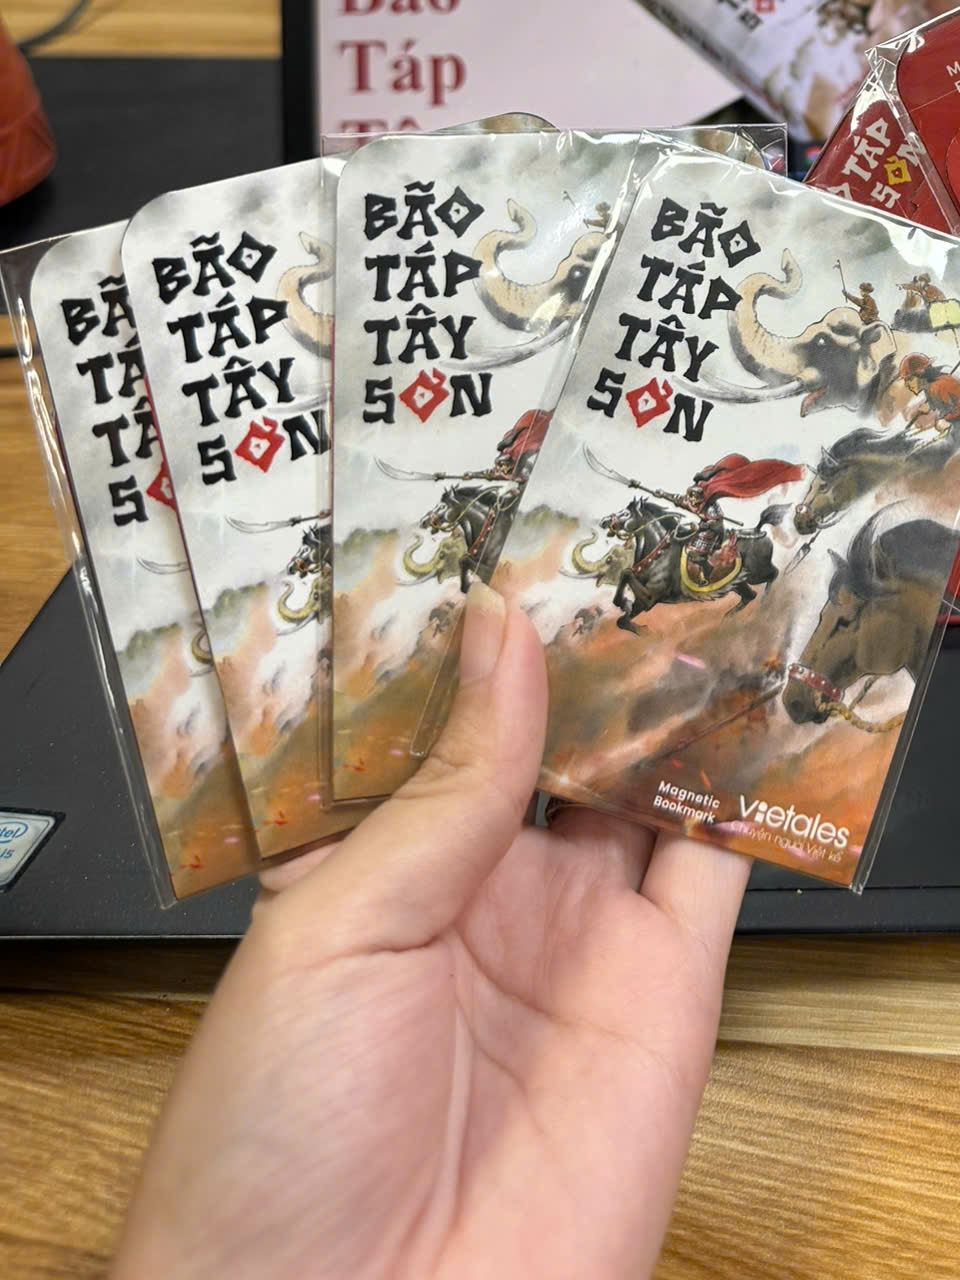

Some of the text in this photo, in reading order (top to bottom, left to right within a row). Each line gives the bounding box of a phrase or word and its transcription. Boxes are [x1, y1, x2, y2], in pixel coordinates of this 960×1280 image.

[337, 38, 468, 108] Táp
[842, 117, 892, 182] TÁP
[870, 131, 928, 209] SƠN
[364, 181, 485, 241] BÃO
[651, 196, 762, 268] BÃO
[152, 231, 278, 305] BÃO
[364, 241, 482, 303] TÁP
[636, 254, 743, 320] TÁP
[61, 272, 137, 347] BÃ
[167, 291, 289, 364] TÁP
[364, 302, 478, 366] TÂY
[76, 334, 146, 405] TÁ
[614, 311, 720, 383] TÂY
[182, 355, 297, 428] TÂY
[363, 367, 493, 424] SƠN
[586, 367, 714, 443] SƠN
[92, 396, 160, 468] TÂ
[197, 409, 332, 486] SƠN
[652, 794, 717, 825] Bookmark
[657, 779, 721, 810] Magnetic
[738, 793, 850, 849] Vietales
[0, 826, 21, 839] tel
